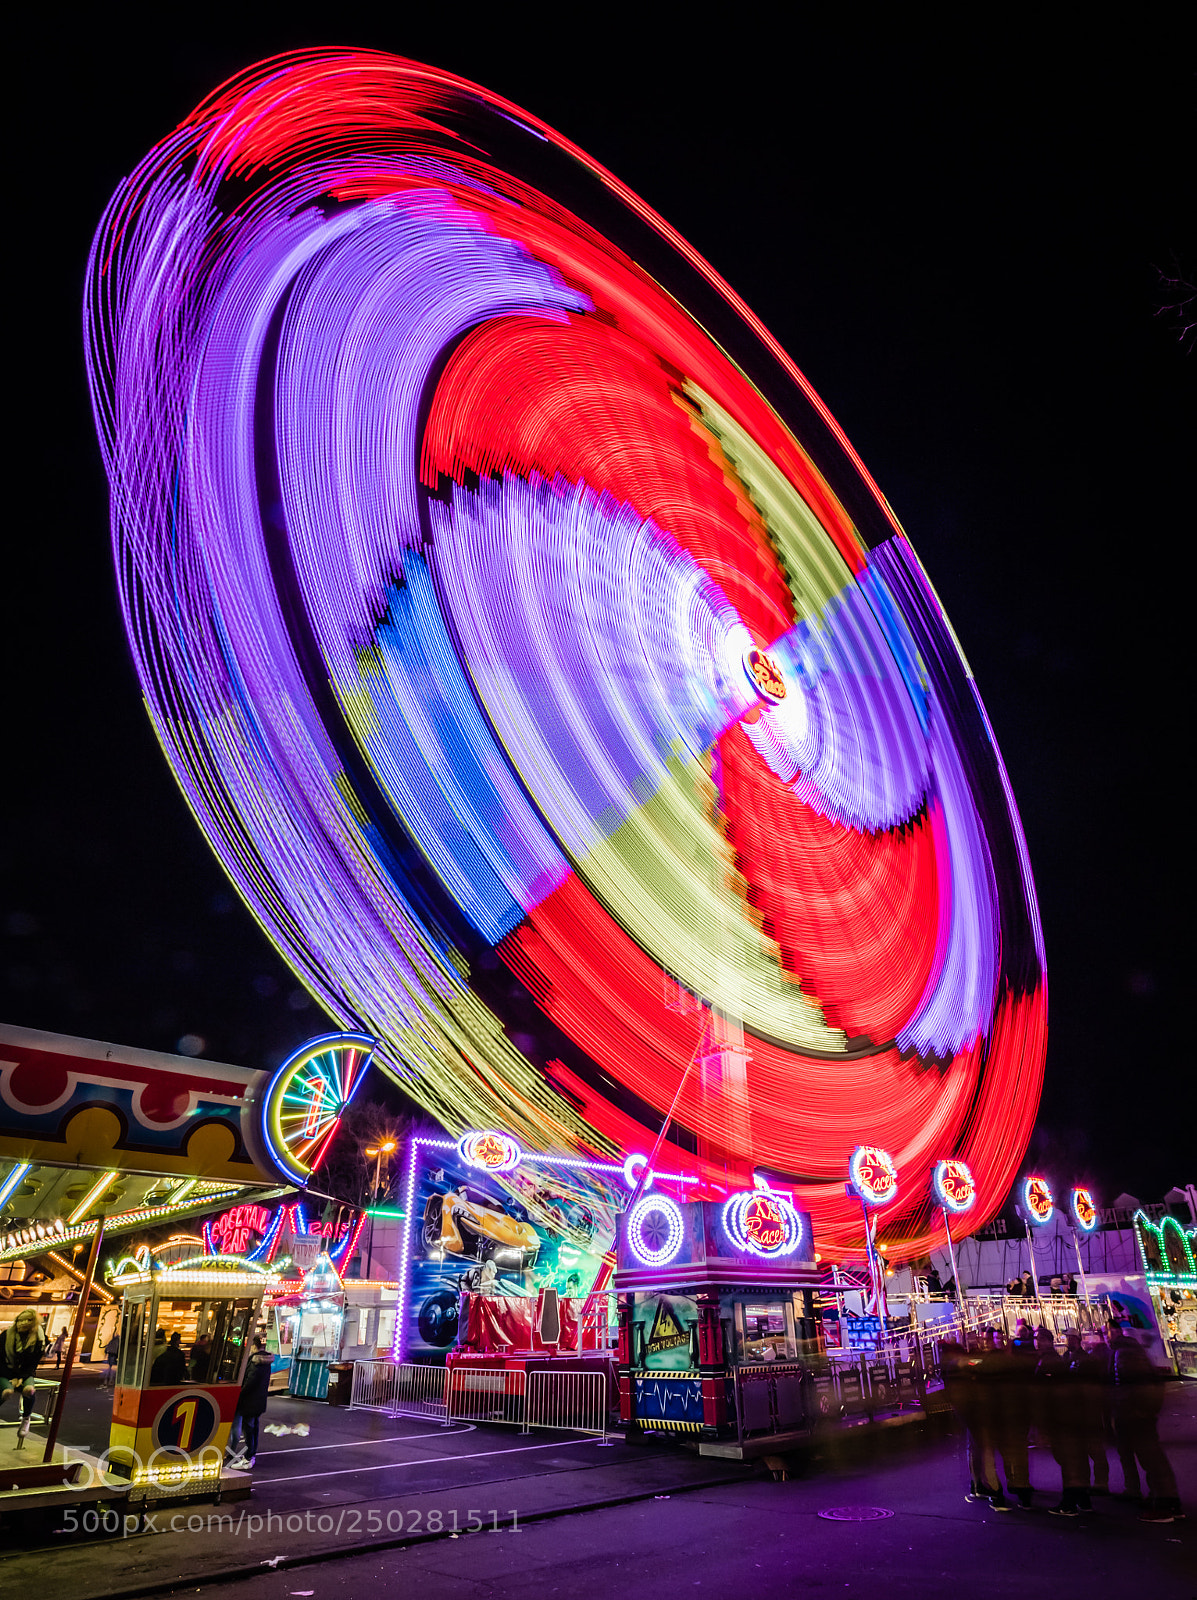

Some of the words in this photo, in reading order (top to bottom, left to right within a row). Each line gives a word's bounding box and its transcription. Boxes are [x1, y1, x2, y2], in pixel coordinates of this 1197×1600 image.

[858, 1167, 896, 1192] Racer
[942, 1179, 975, 1201] Racer
[211, 1204, 268, 1244] COCKTAIL
[221, 1227, 250, 1254] BAR
[201, 1260, 240, 1271] KASSE
[171, 1398, 199, 1451] 1
